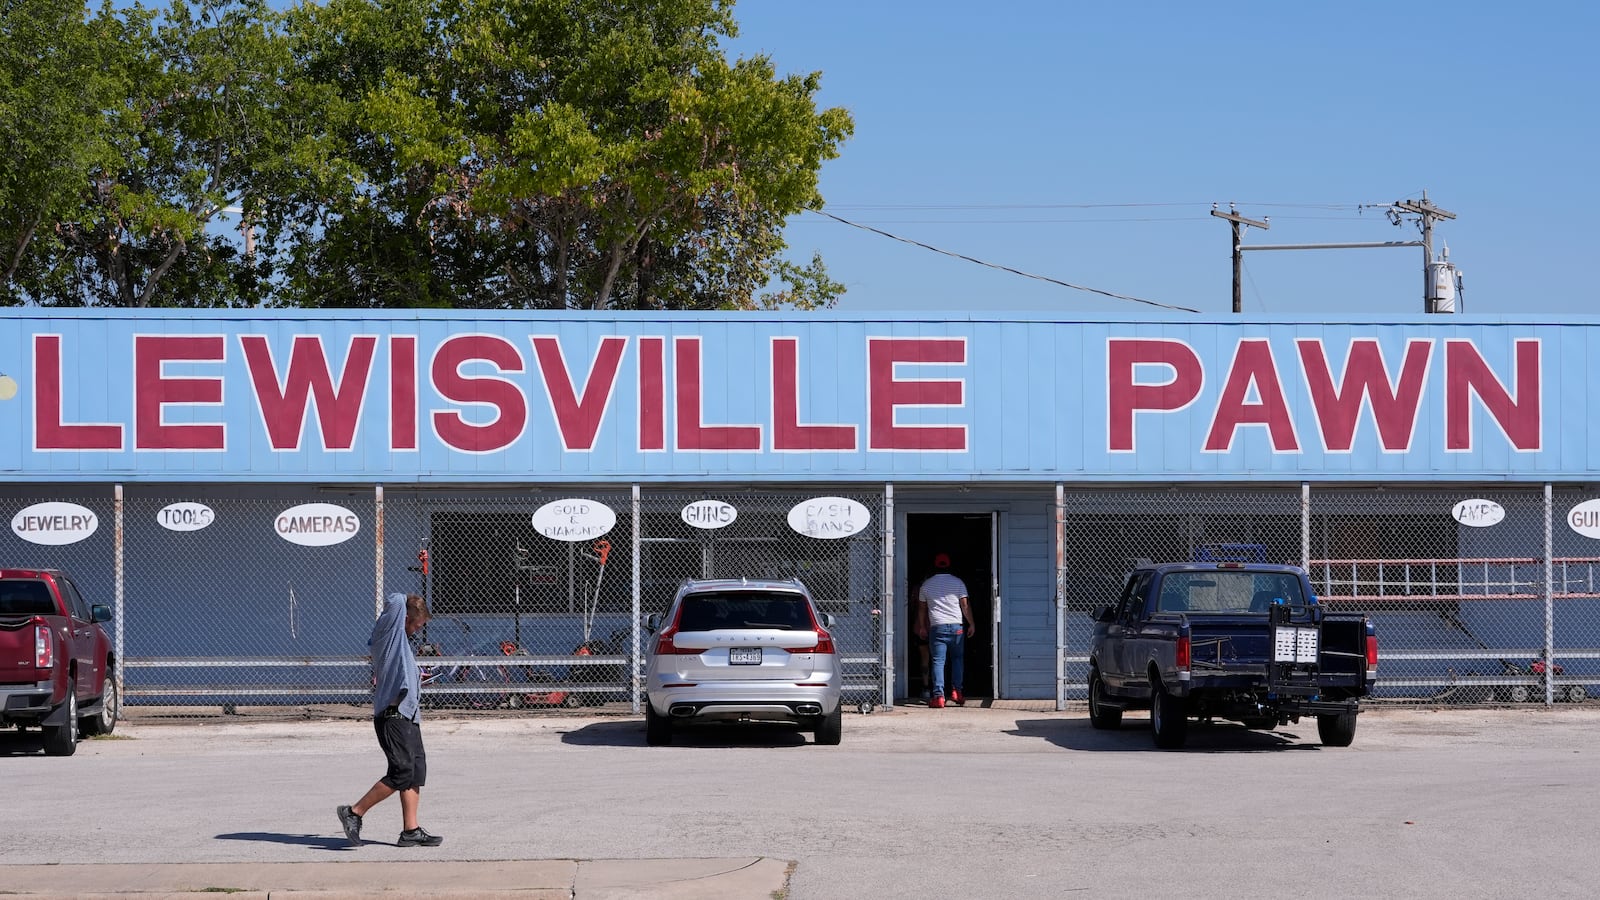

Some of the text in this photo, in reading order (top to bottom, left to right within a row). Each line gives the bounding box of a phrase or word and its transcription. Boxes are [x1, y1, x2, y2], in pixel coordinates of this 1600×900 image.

[31, 332, 1543, 455] LEWISVILLE PAWN
[163, 508, 212, 526] TOOLS
[553, 504, 590, 515] GOLD
[686, 505, 732, 522] GUNS
[16, 514, 94, 532] JEWELRY
[277, 515, 358, 534] CAMERAS
[803, 519, 855, 534] OANS
